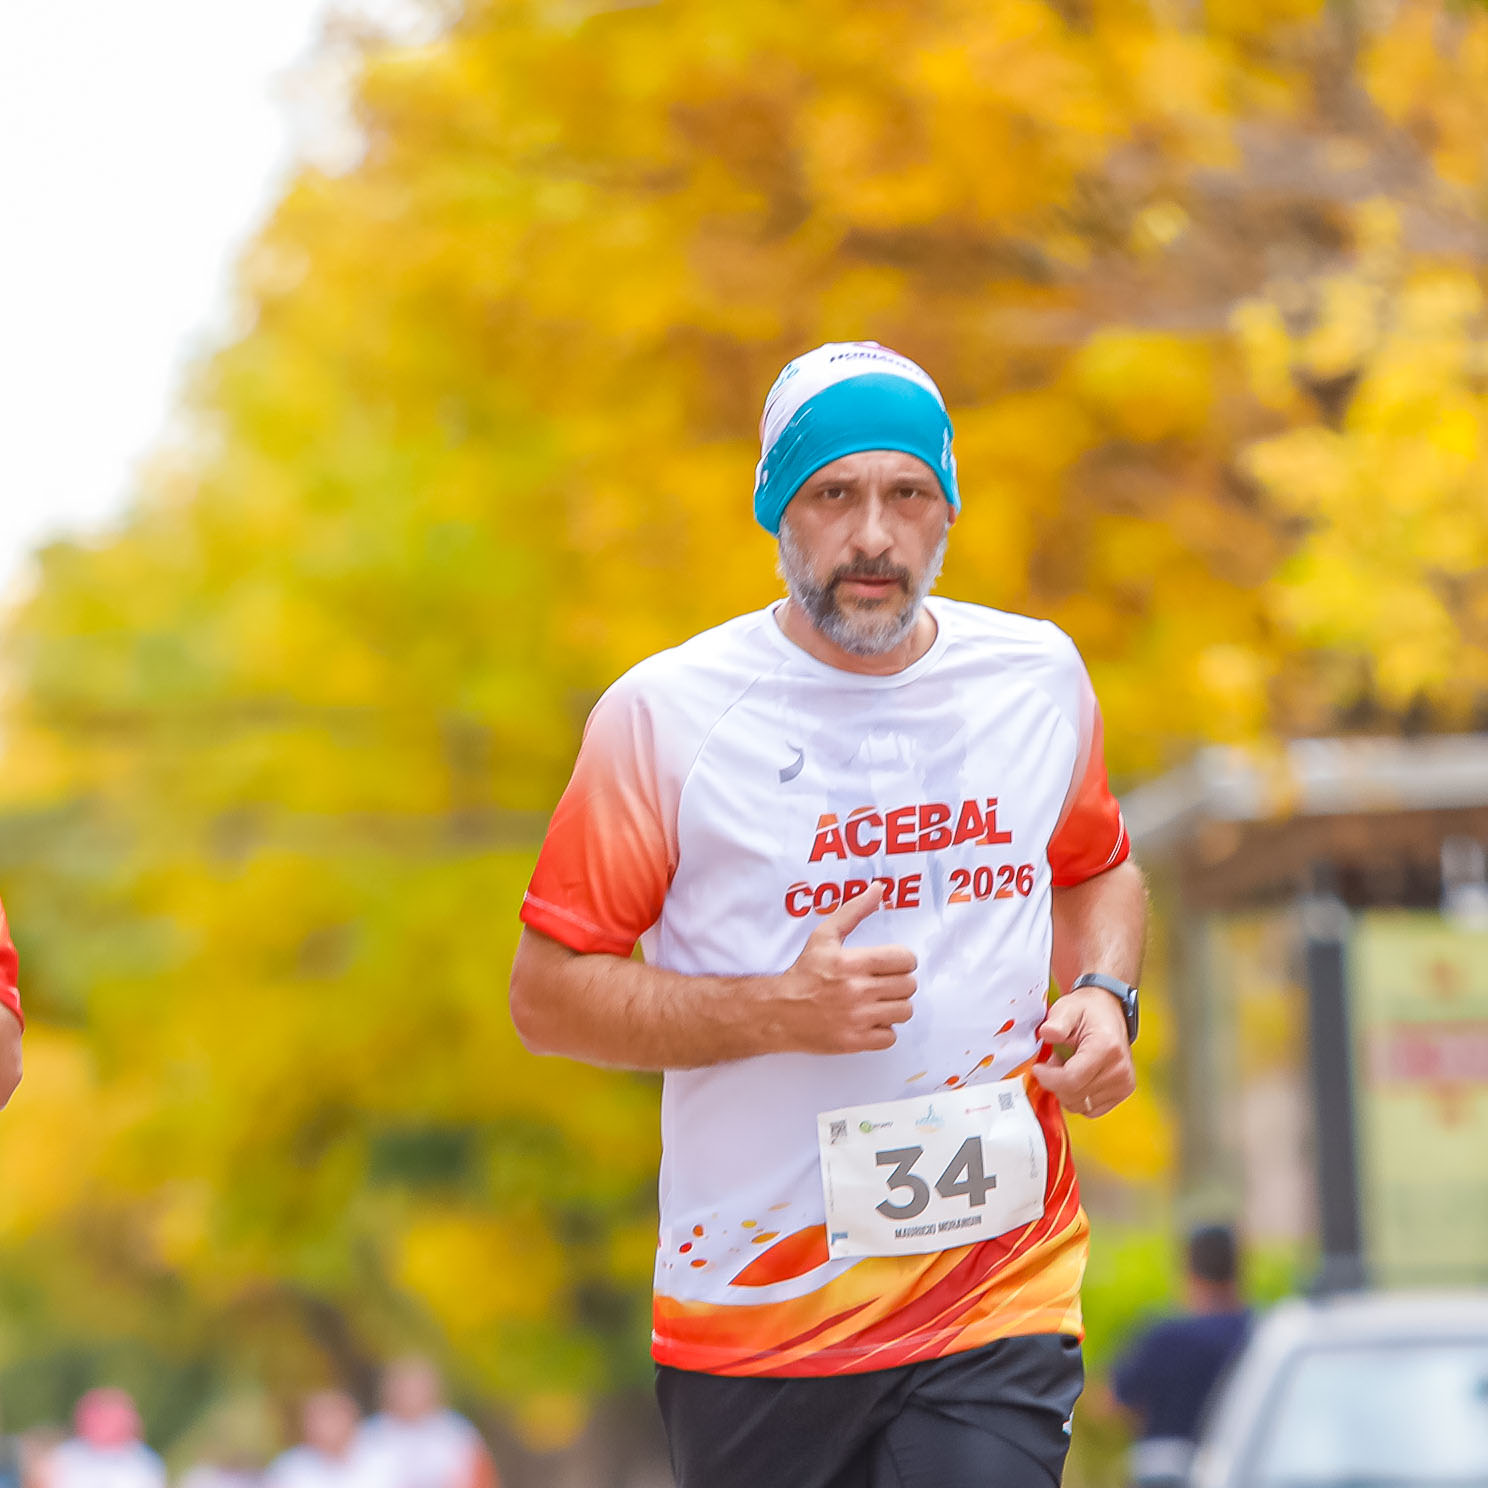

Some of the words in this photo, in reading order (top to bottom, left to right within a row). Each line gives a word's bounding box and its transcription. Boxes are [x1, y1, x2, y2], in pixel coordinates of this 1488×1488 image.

[807, 797, 1012, 864] ACEBAL
[947, 863, 1034, 905] 2026
[875, 1135, 997, 1220] 34
